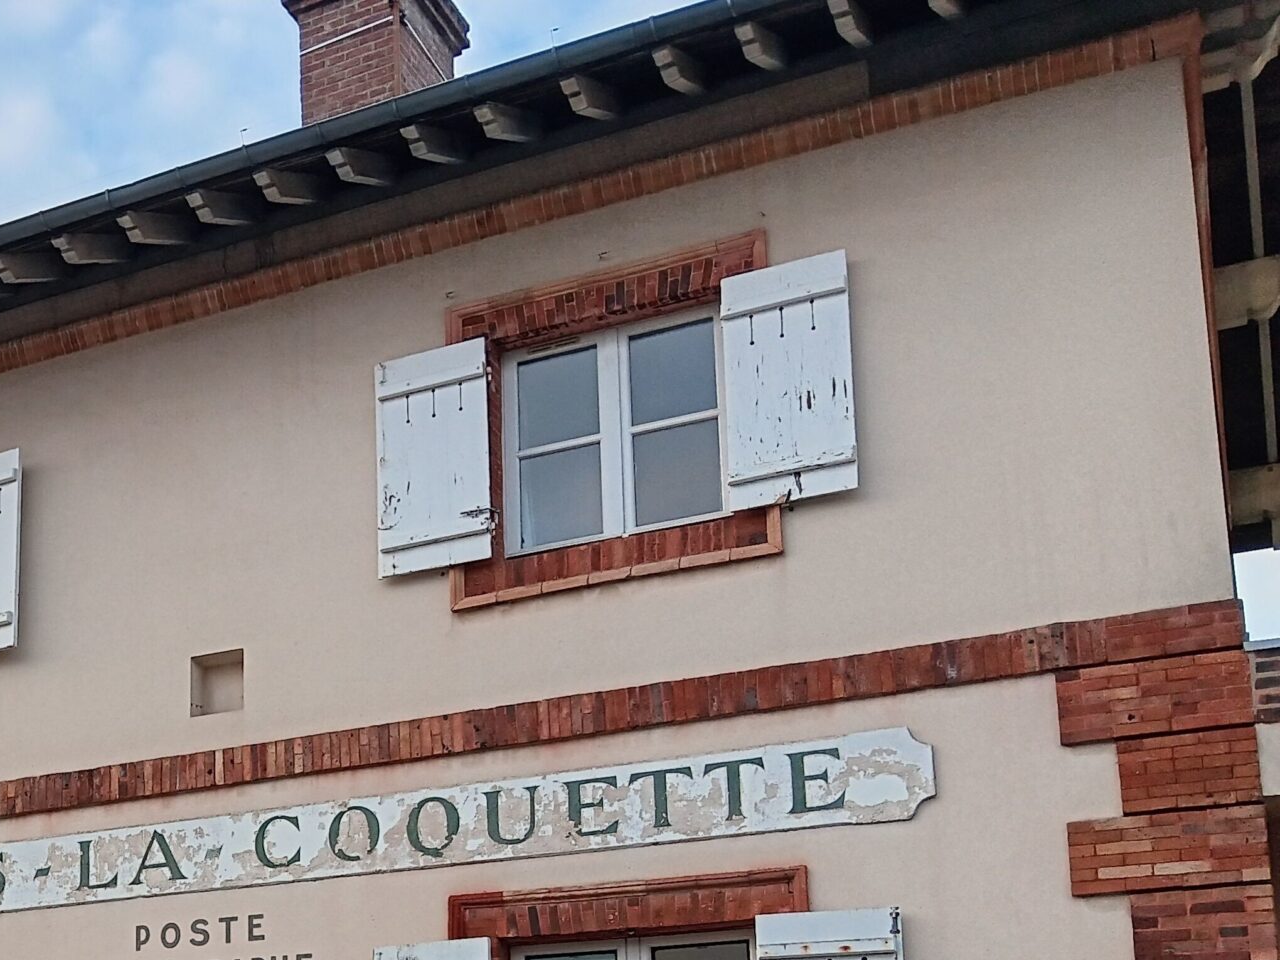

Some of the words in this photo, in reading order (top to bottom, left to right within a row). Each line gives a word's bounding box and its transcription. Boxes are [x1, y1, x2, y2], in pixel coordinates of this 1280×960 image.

[76, 829, 188, 891] LA
[255, 747, 847, 869] COQUETTE
[135, 913, 265, 951] POSTE
